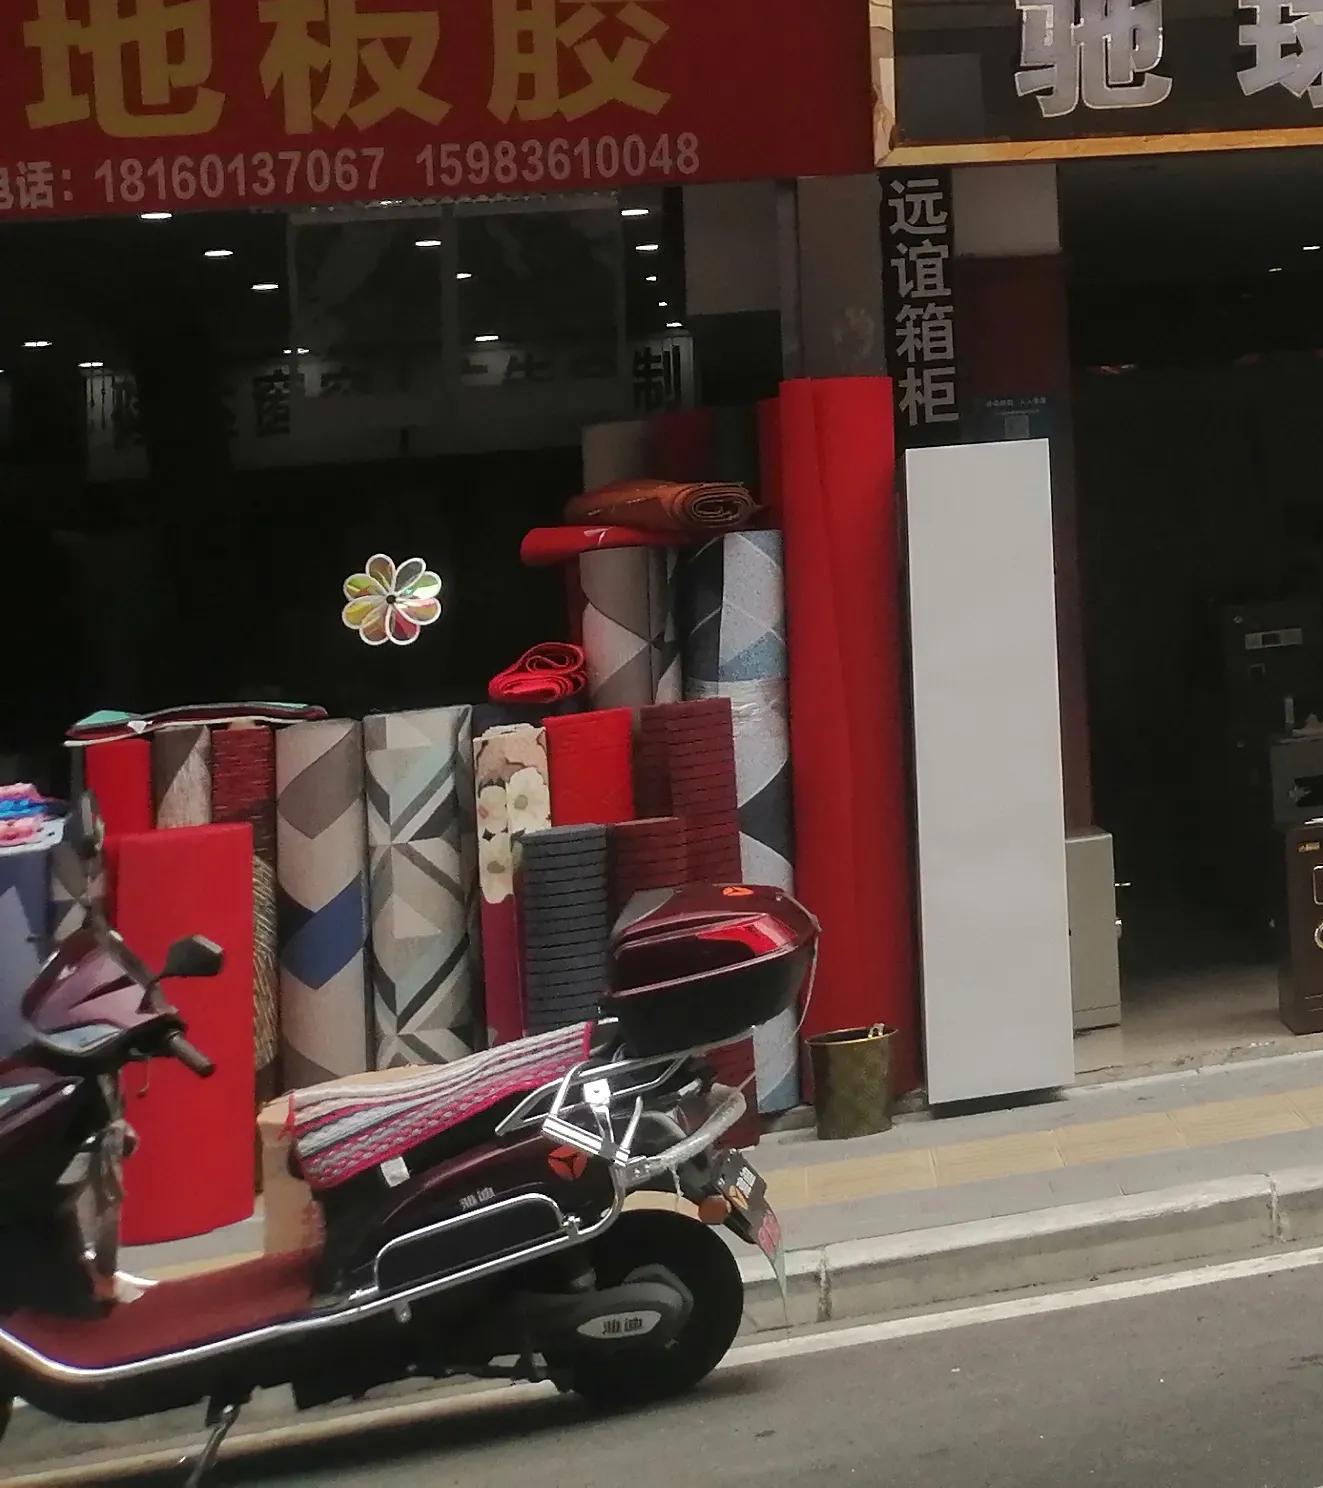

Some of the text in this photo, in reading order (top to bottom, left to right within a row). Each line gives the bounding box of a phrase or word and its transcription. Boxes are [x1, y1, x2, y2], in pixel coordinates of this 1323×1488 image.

[416, 132, 702, 190] 15983610048
[887, 178, 960, 426] 远谊箱柜
